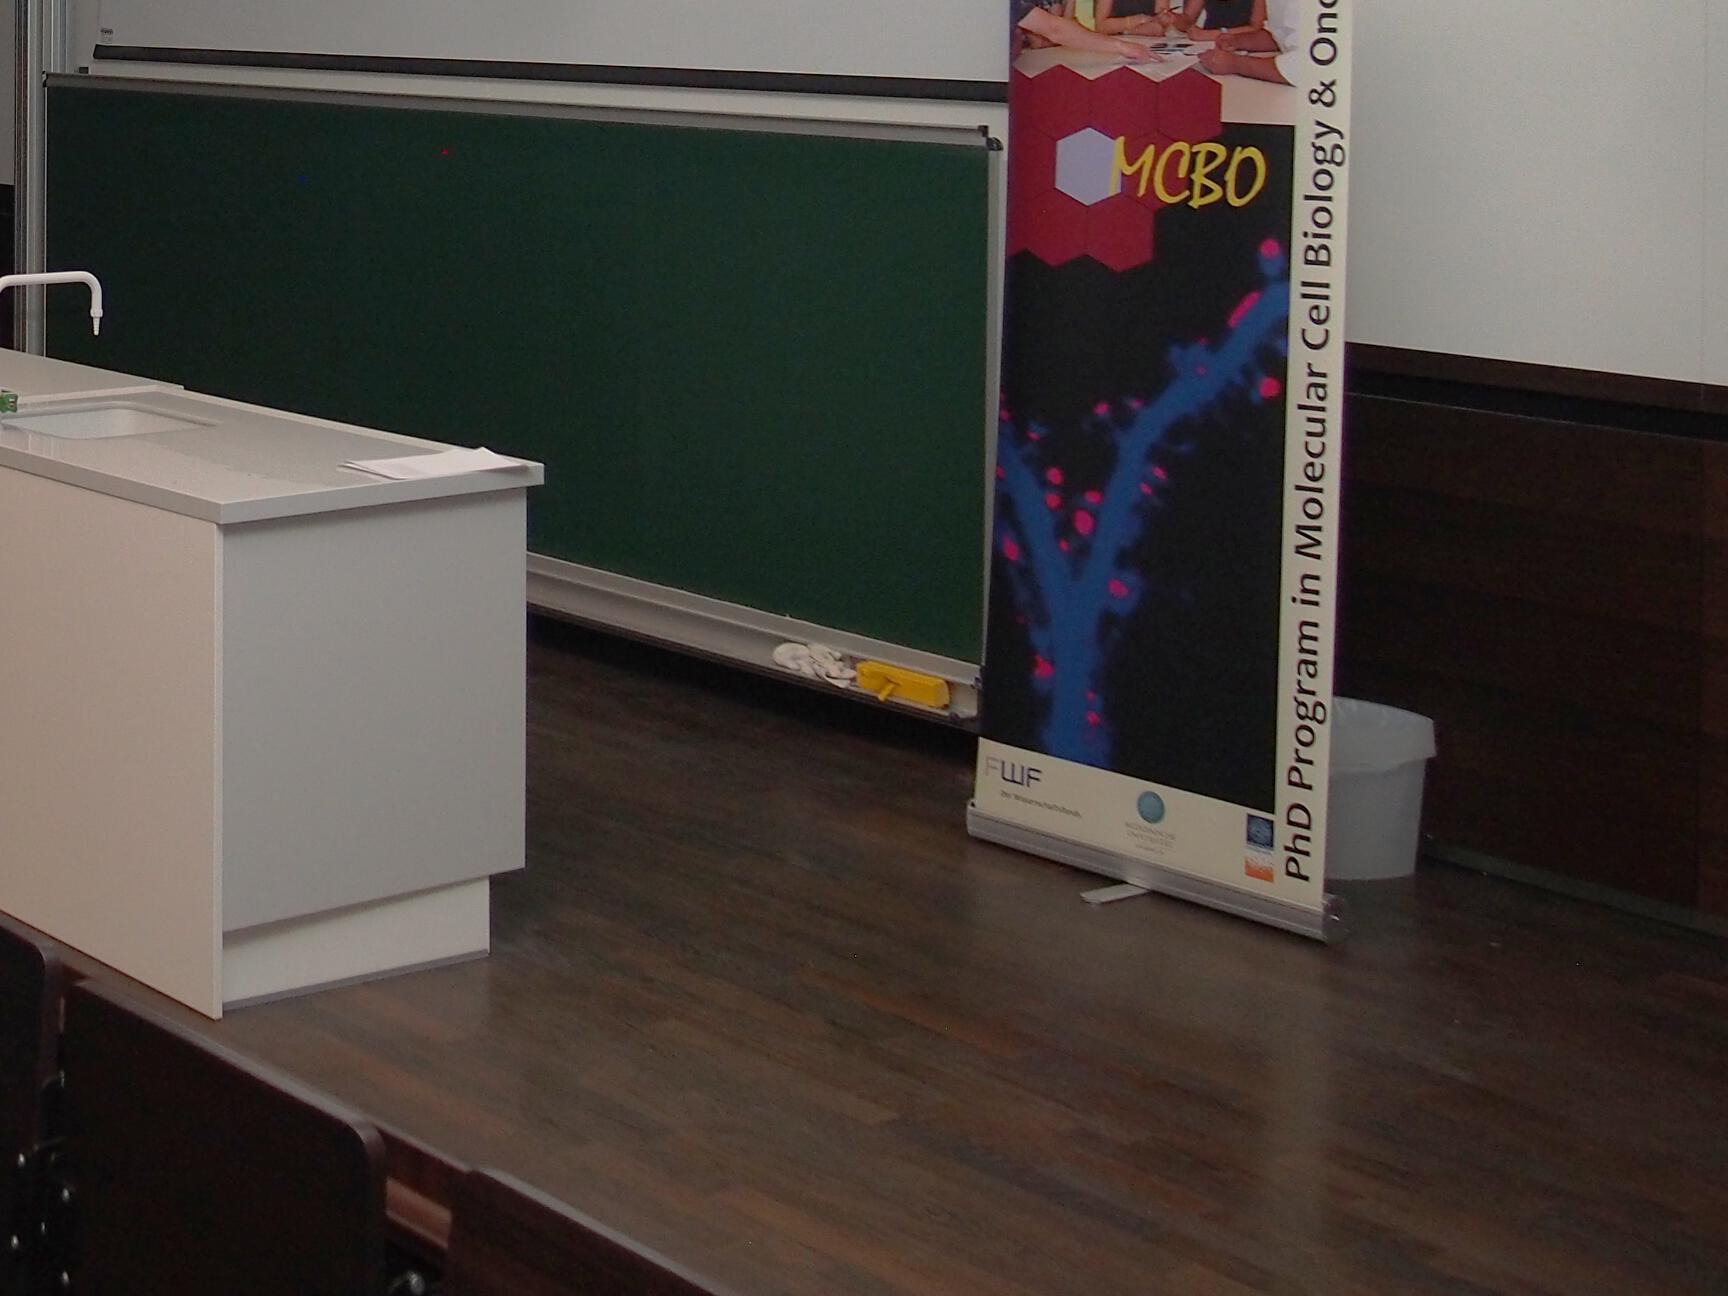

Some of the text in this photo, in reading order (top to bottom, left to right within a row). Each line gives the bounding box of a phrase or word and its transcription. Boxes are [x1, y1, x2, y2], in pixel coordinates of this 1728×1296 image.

[1308, 78, 1338, 108] &
[1109, 136, 1268, 209] MCBO
[1302, 119, 1346, 268] Biology
[1300, 279, 1332, 352] Cell
[1294, 361, 1329, 561] Molecular
[1292, 573, 1323, 610] in
[1287, 620, 1327, 791] Program
[1284, 803, 1312, 882] PhD
